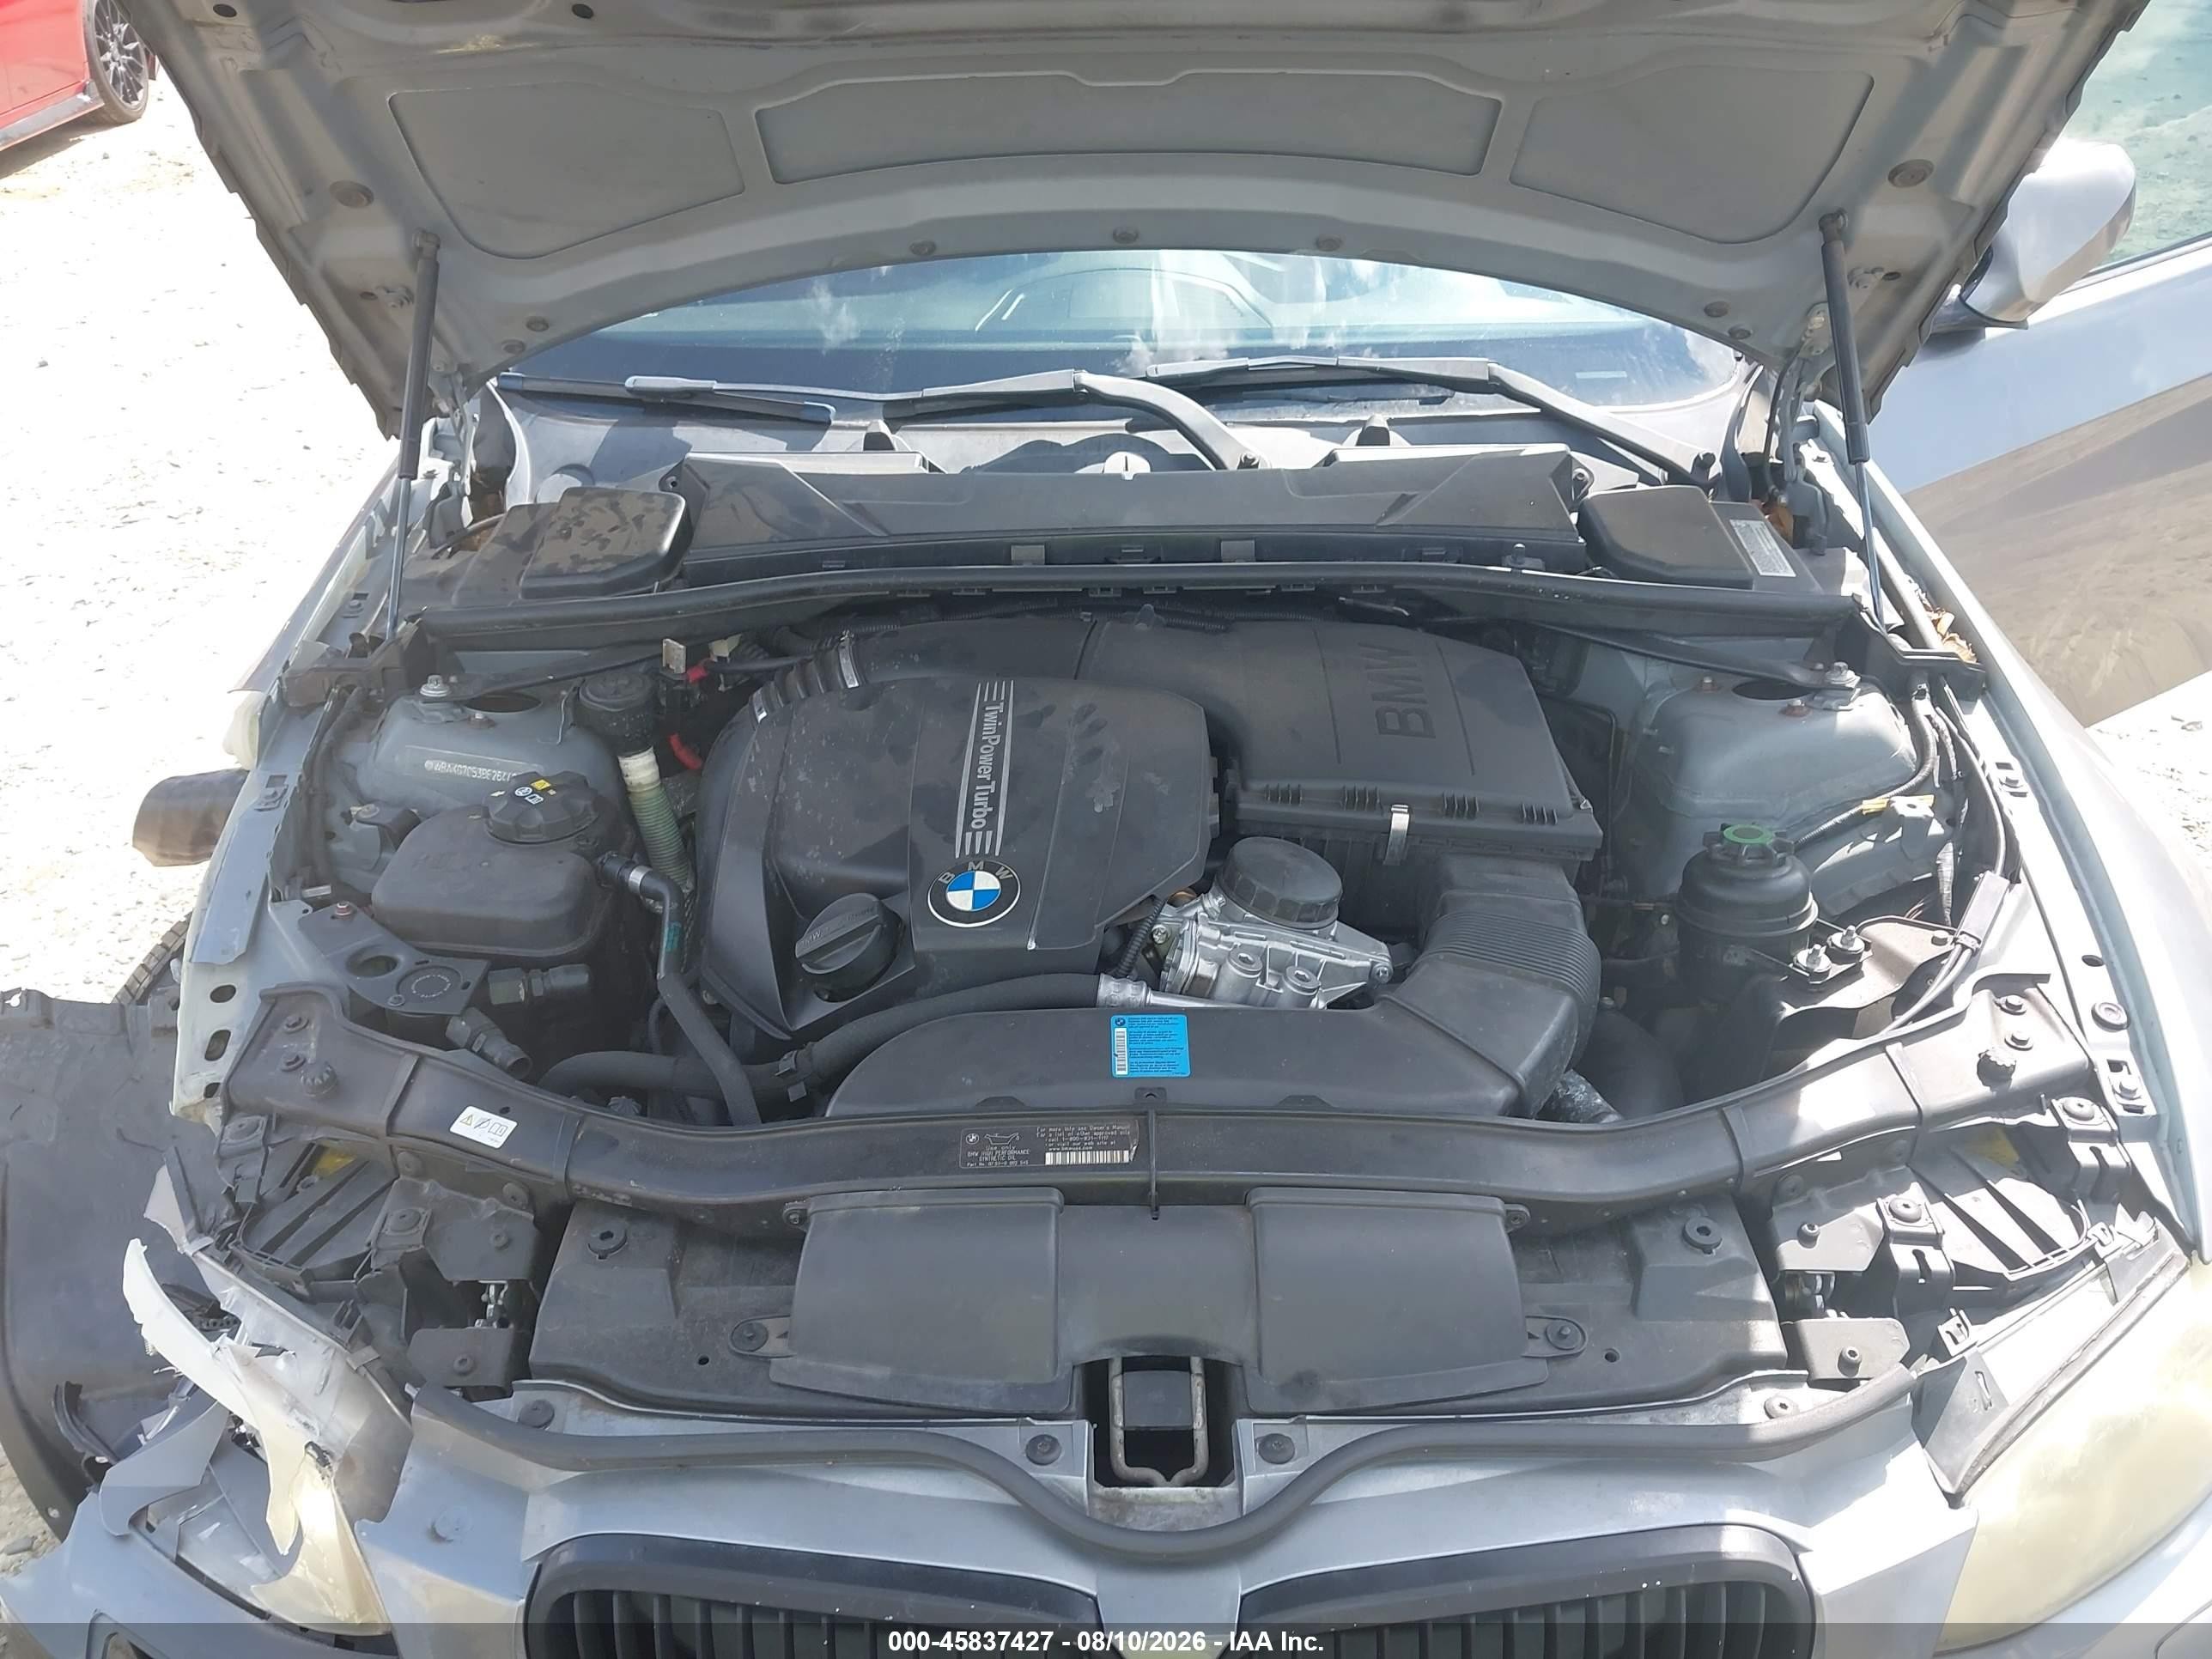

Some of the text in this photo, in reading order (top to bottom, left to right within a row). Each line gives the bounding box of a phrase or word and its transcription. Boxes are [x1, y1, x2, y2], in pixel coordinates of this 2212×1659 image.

[970, 701, 1005, 830] TwinPower Turbo
[938, 860, 1014, 885] BMW
